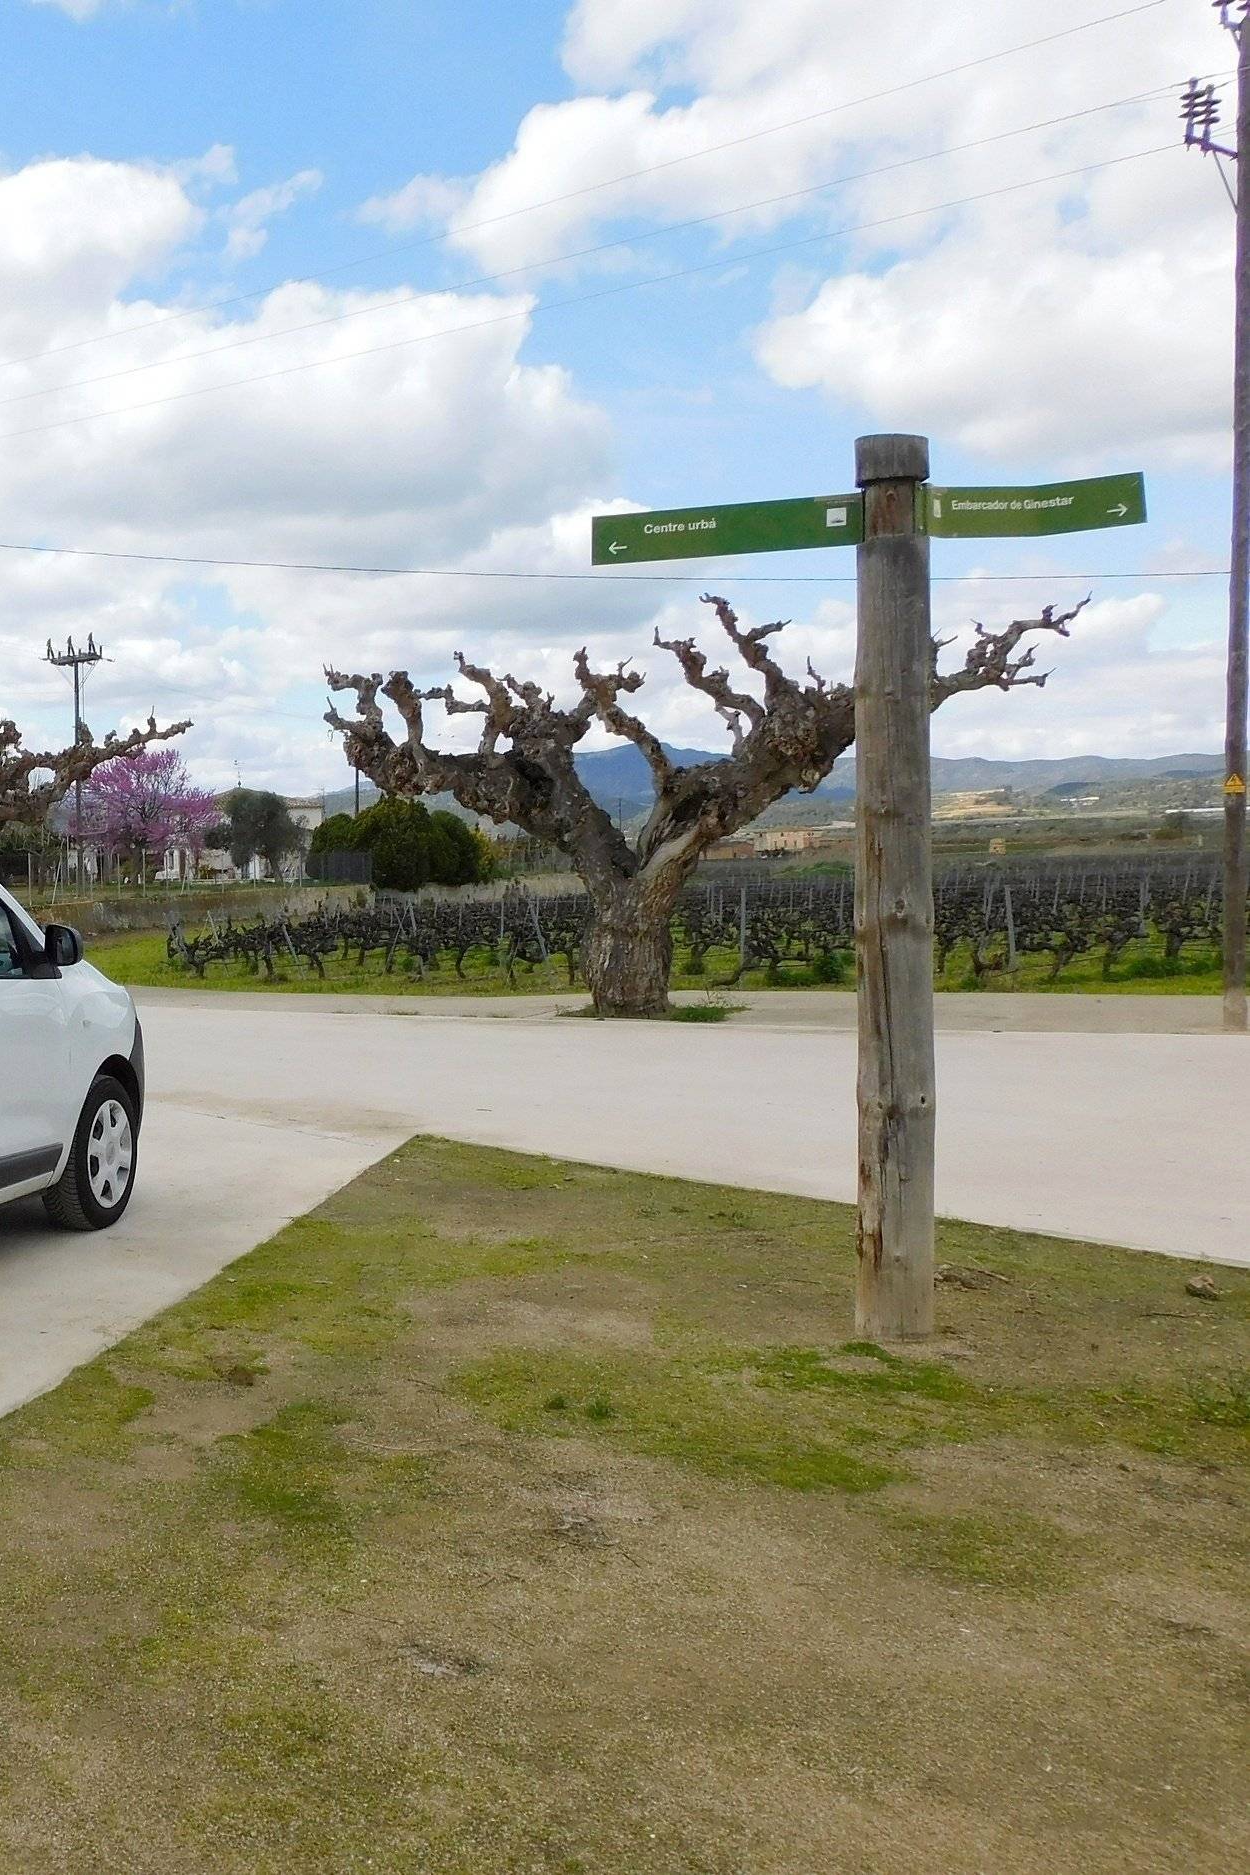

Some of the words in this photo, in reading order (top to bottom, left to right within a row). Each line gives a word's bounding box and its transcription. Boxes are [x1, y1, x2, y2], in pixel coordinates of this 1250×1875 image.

[951, 500, 1010, 510] Embarcador
[1011, 500, 1022, 510] de
[1023, 496, 1075, 510] Ginestar
[644, 522, 685, 534] Centre
